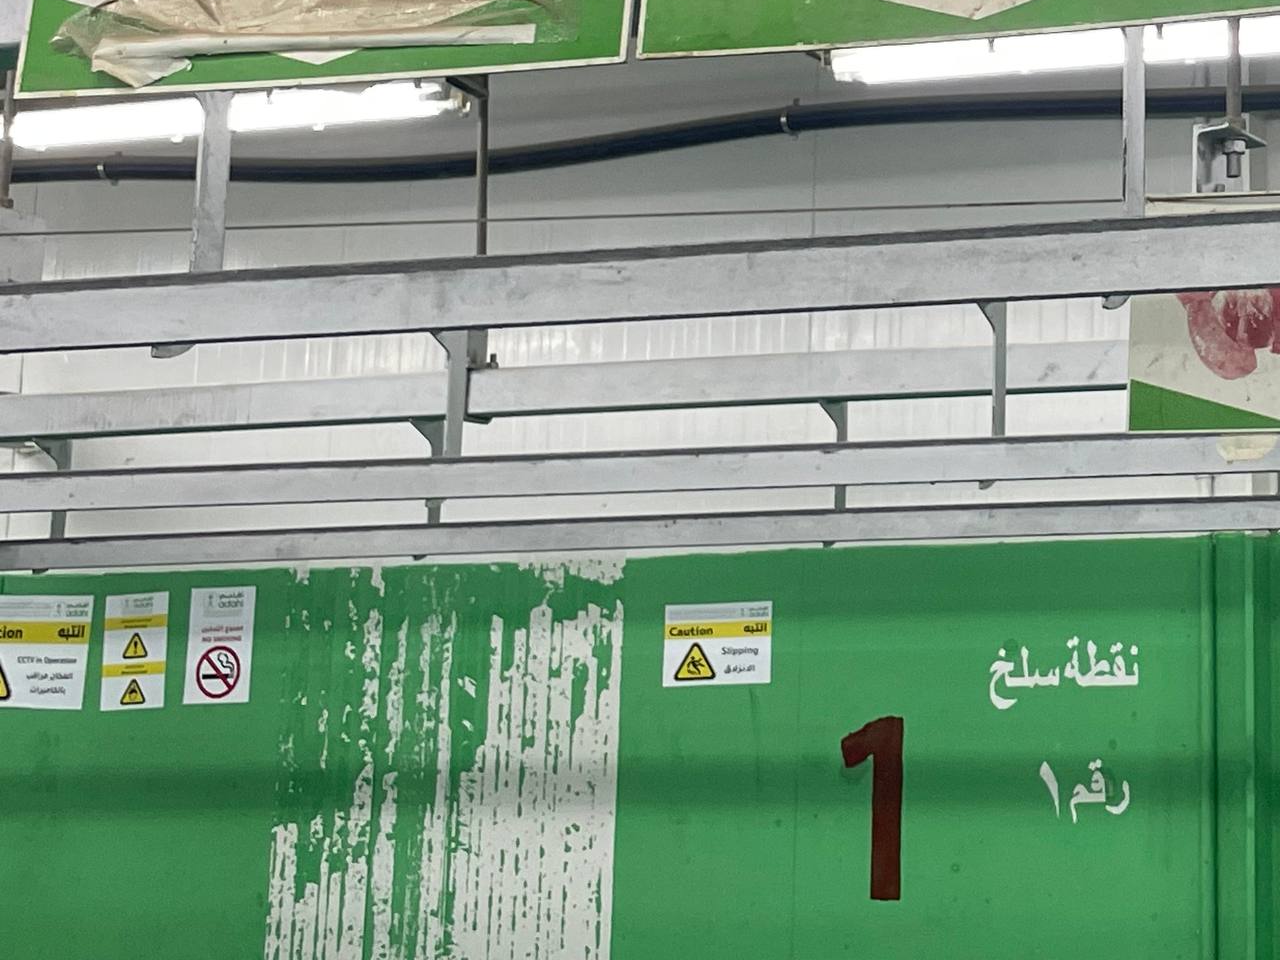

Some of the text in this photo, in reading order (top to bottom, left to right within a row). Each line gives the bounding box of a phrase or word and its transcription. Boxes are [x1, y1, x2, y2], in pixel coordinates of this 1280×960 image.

[57, 624, 86, 640] انتبه
[668, 626, 714, 637] Caution
[743, 623, 768, 634] انتبه
[720, 646, 760, 656] Slipping
[988, 635, 1140, 711] نقطة سلخ
[1070, 758, 1131, 825] رقم
[840, 715, 905, 902] 1
